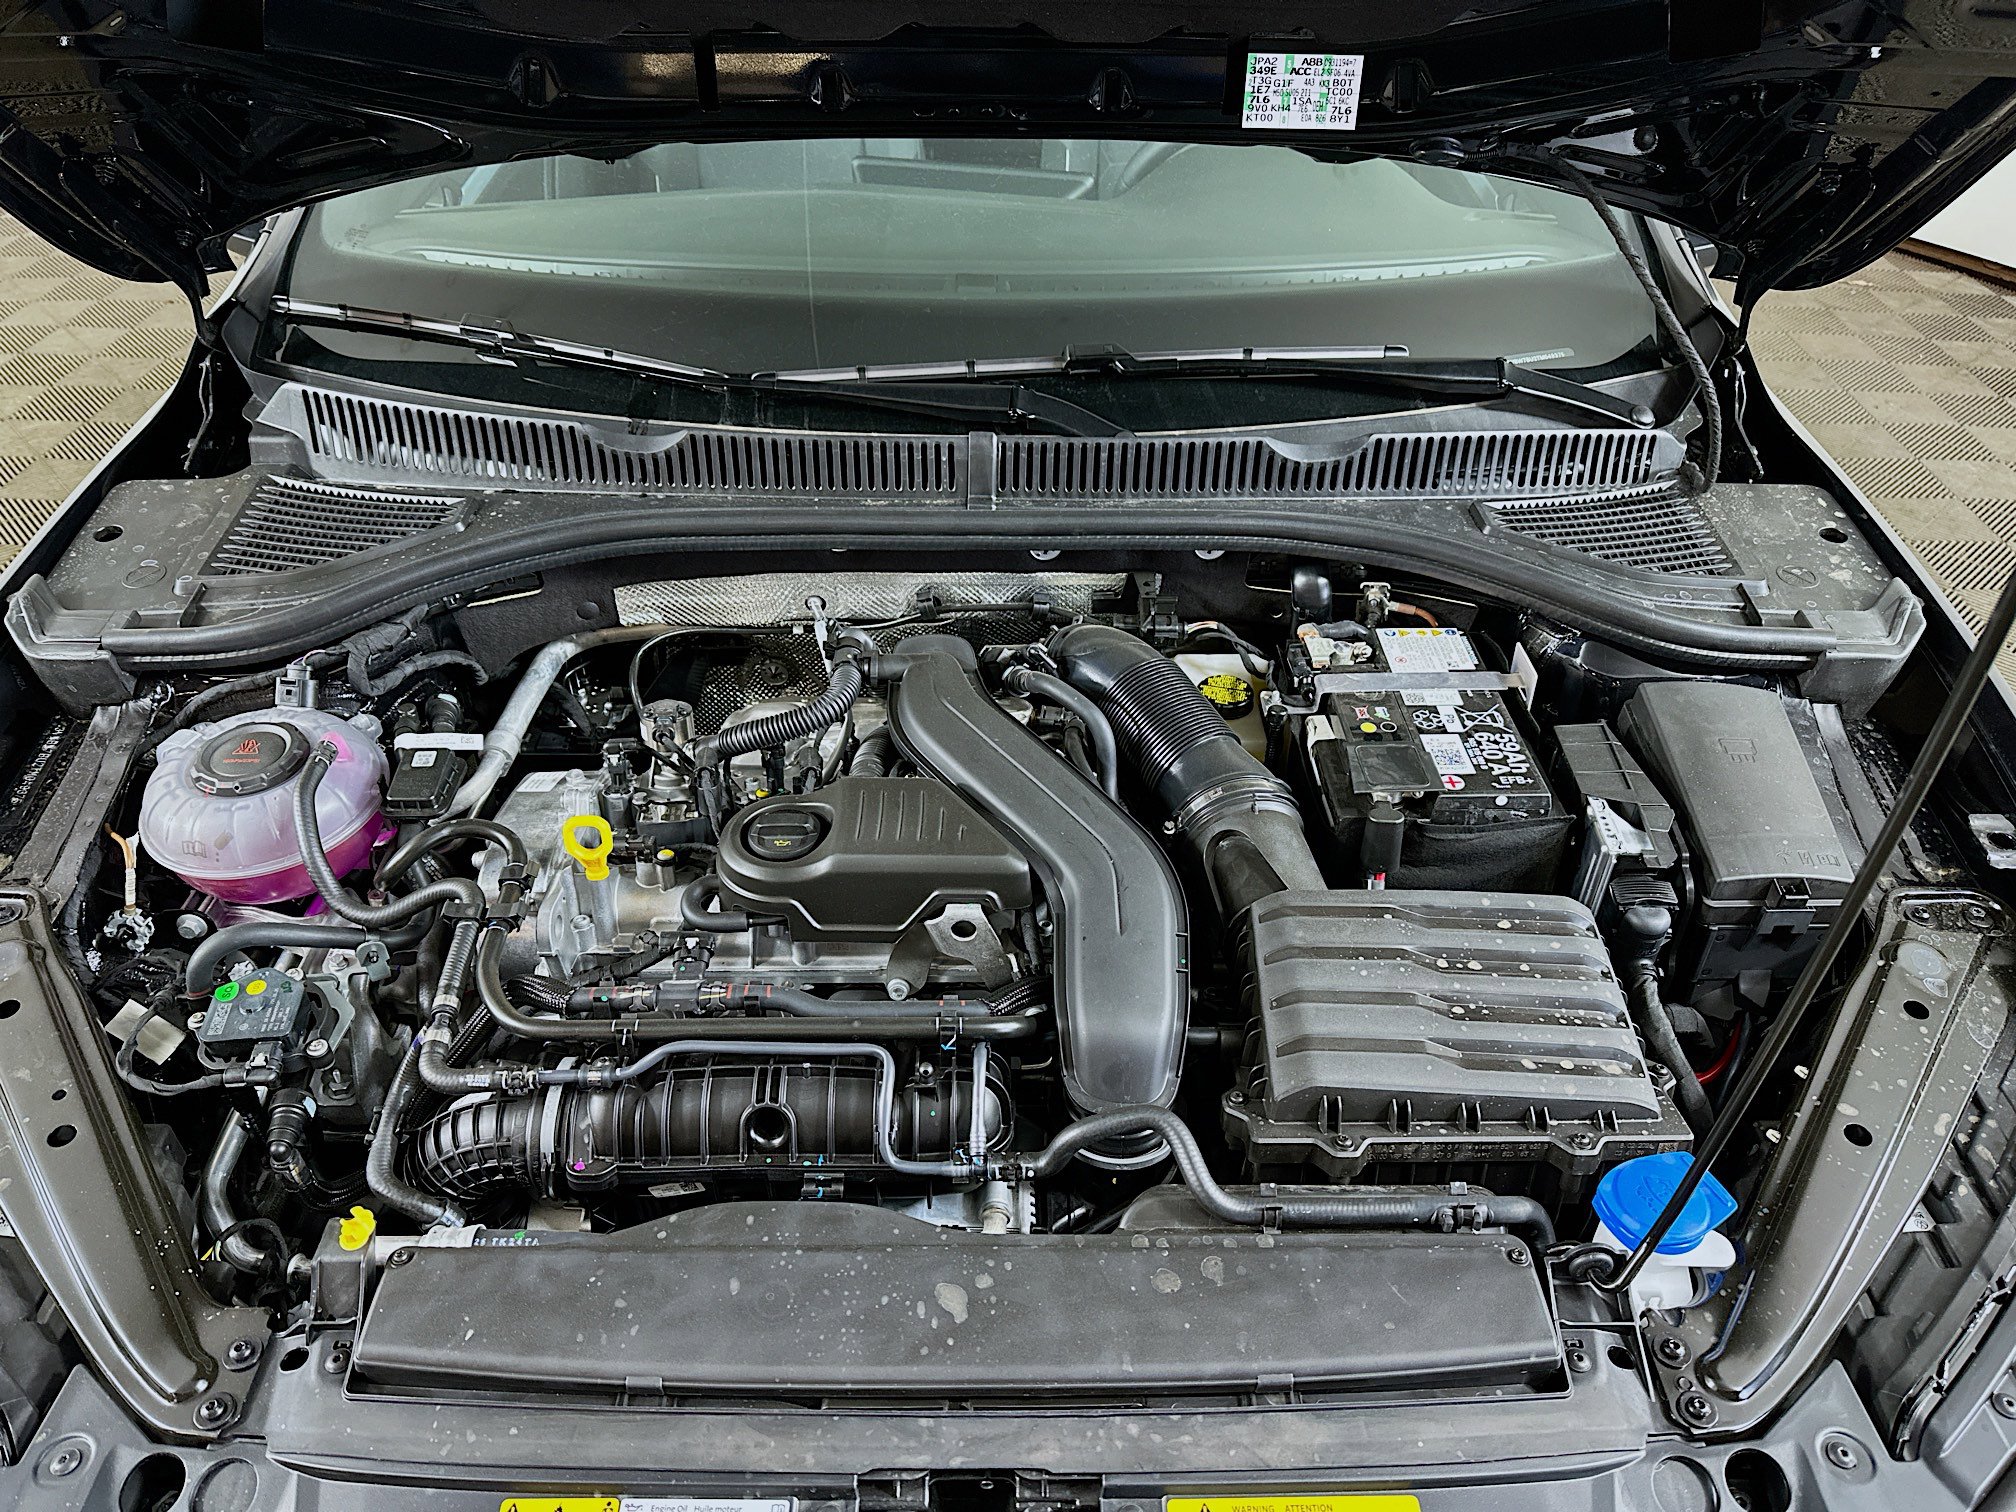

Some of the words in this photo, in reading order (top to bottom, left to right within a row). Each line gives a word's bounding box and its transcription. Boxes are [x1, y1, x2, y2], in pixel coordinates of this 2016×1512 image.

[1250, 57, 1278, 66] JPA2
[1249, 66, 1278, 75] 349E
[1289, 67, 1312, 76] ACC
[1252, 76, 1272, 85] T3G
[1273, 79, 1294, 88] G1F
[1250, 85, 1271, 94] 1E7
[1250, 95, 1270, 104] 7L6
[1293, 97, 1313, 105] 1SA
[1270, 104, 1291, 112] KH4
[1331, 106, 1352, 115] 7L6
[1473, 731, 1504, 760] 640
[1494, 733, 1531, 774] 59Ah
[1487, 762, 1512, 775] A
[650, 1503, 675, 1512] Engine
[676, 1503, 688, 1512] Oil
[694, 1504, 713, 1512] Huile
[714, 1504, 743, 1512] moteur
[1231, 1504, 1275, 1512] WARNING
[1285, 1503, 1333, 1512] ATTENTION
